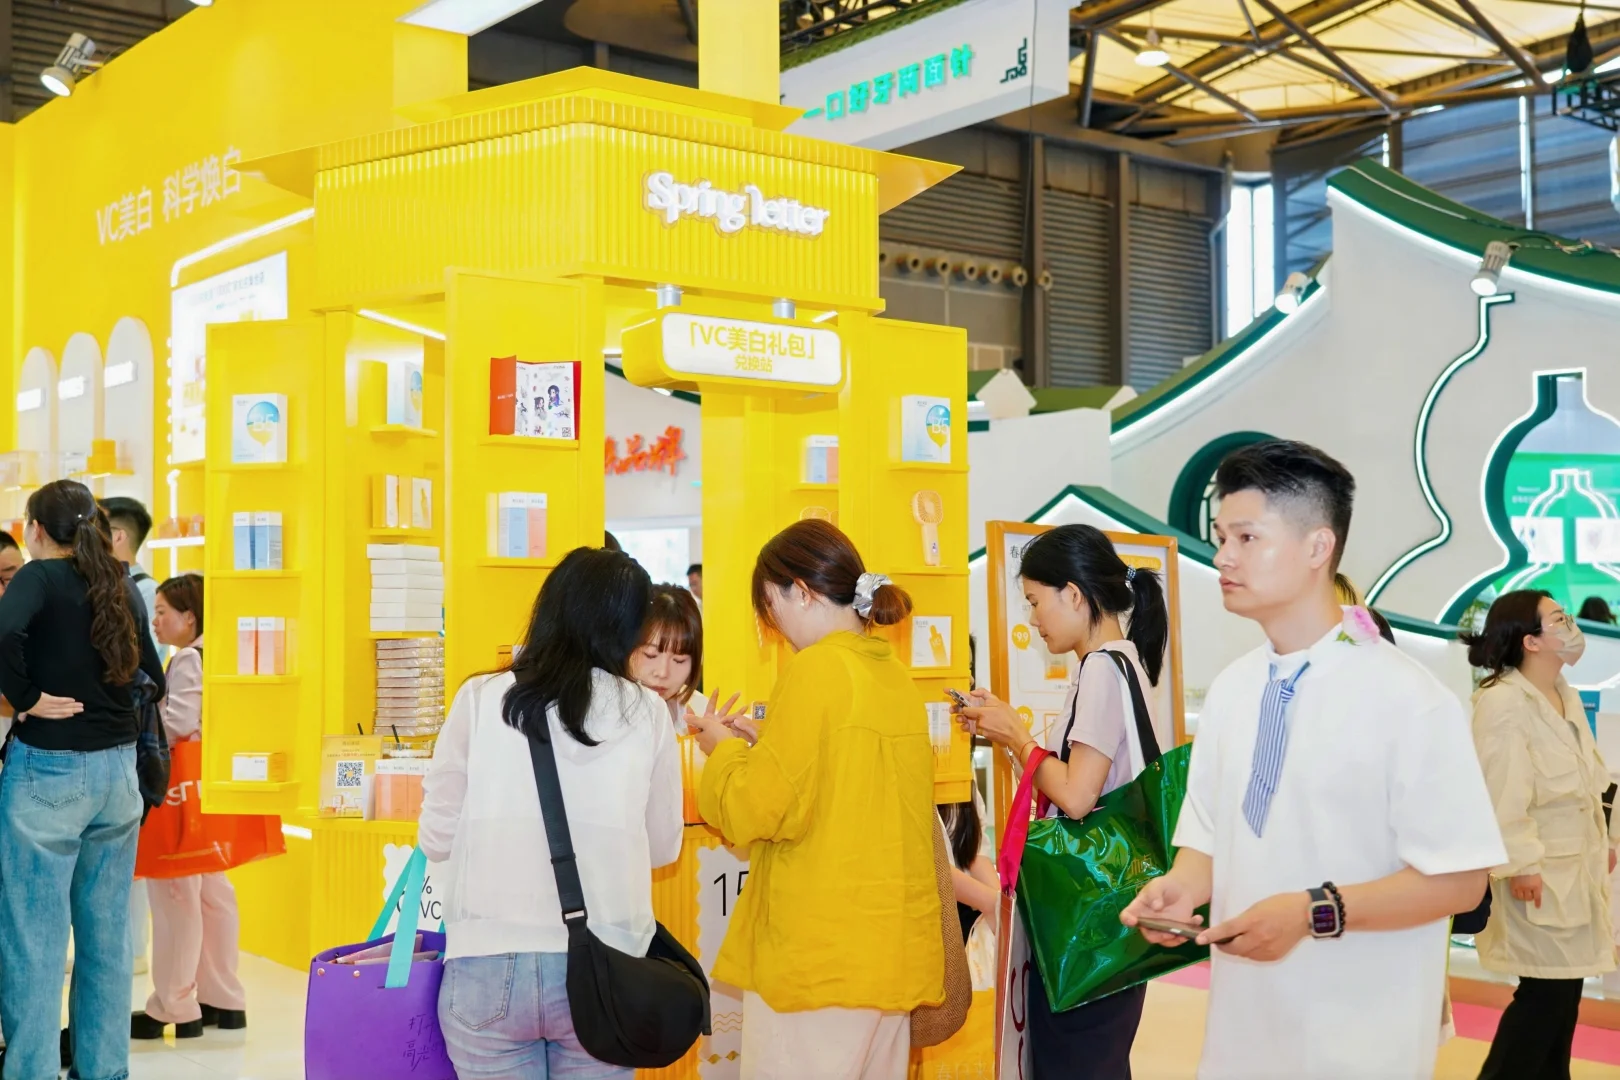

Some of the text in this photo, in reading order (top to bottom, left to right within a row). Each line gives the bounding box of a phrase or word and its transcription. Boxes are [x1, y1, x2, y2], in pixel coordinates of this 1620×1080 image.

[96, 145, 242, 246] VC美白 科学焕白
[647, 172, 830, 236] Spring letter
[734, 354, 773, 373] 兑换站
